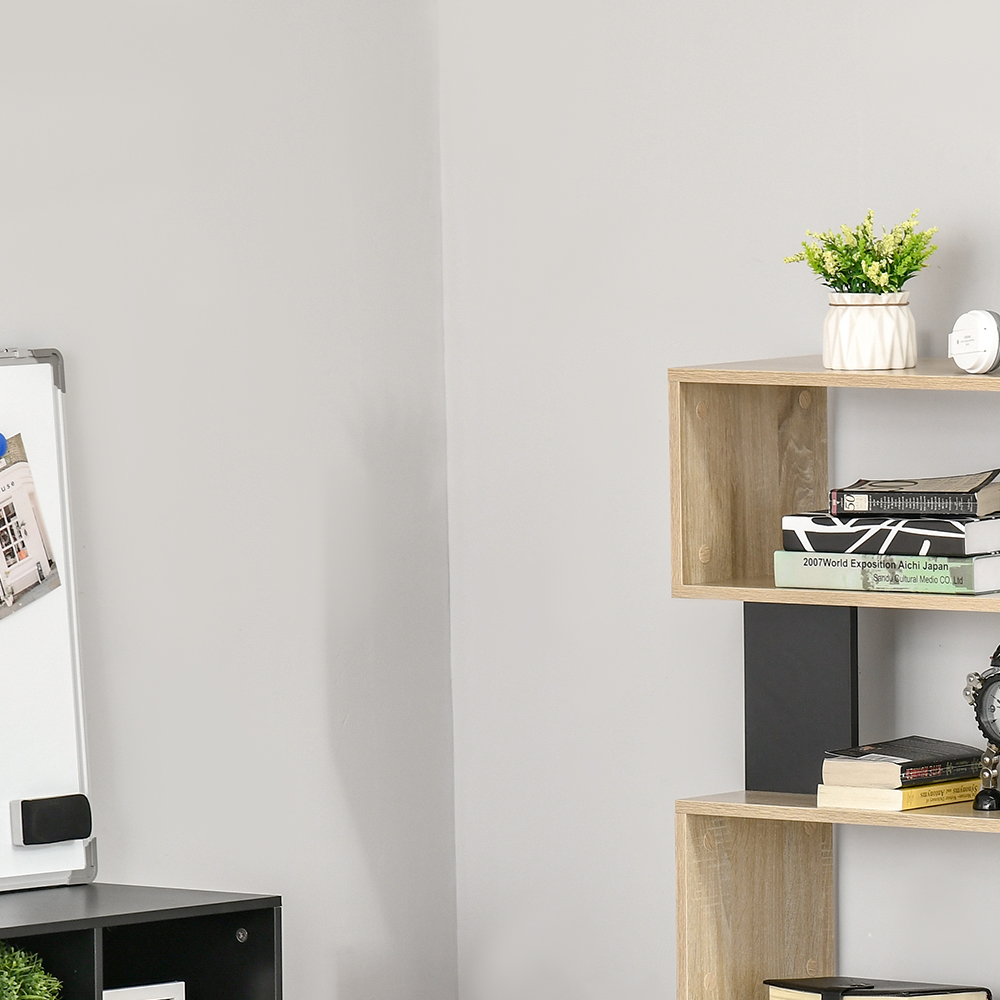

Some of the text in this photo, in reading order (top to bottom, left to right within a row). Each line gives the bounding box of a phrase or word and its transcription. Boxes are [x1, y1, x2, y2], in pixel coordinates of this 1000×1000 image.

[803, 557, 949, 572] 2007World Exposition Aichi Japan
[894, 574, 918, 584] Cultural
[989, 704, 996, 713] 9
[920, 789, 945, 798] Antonyms
